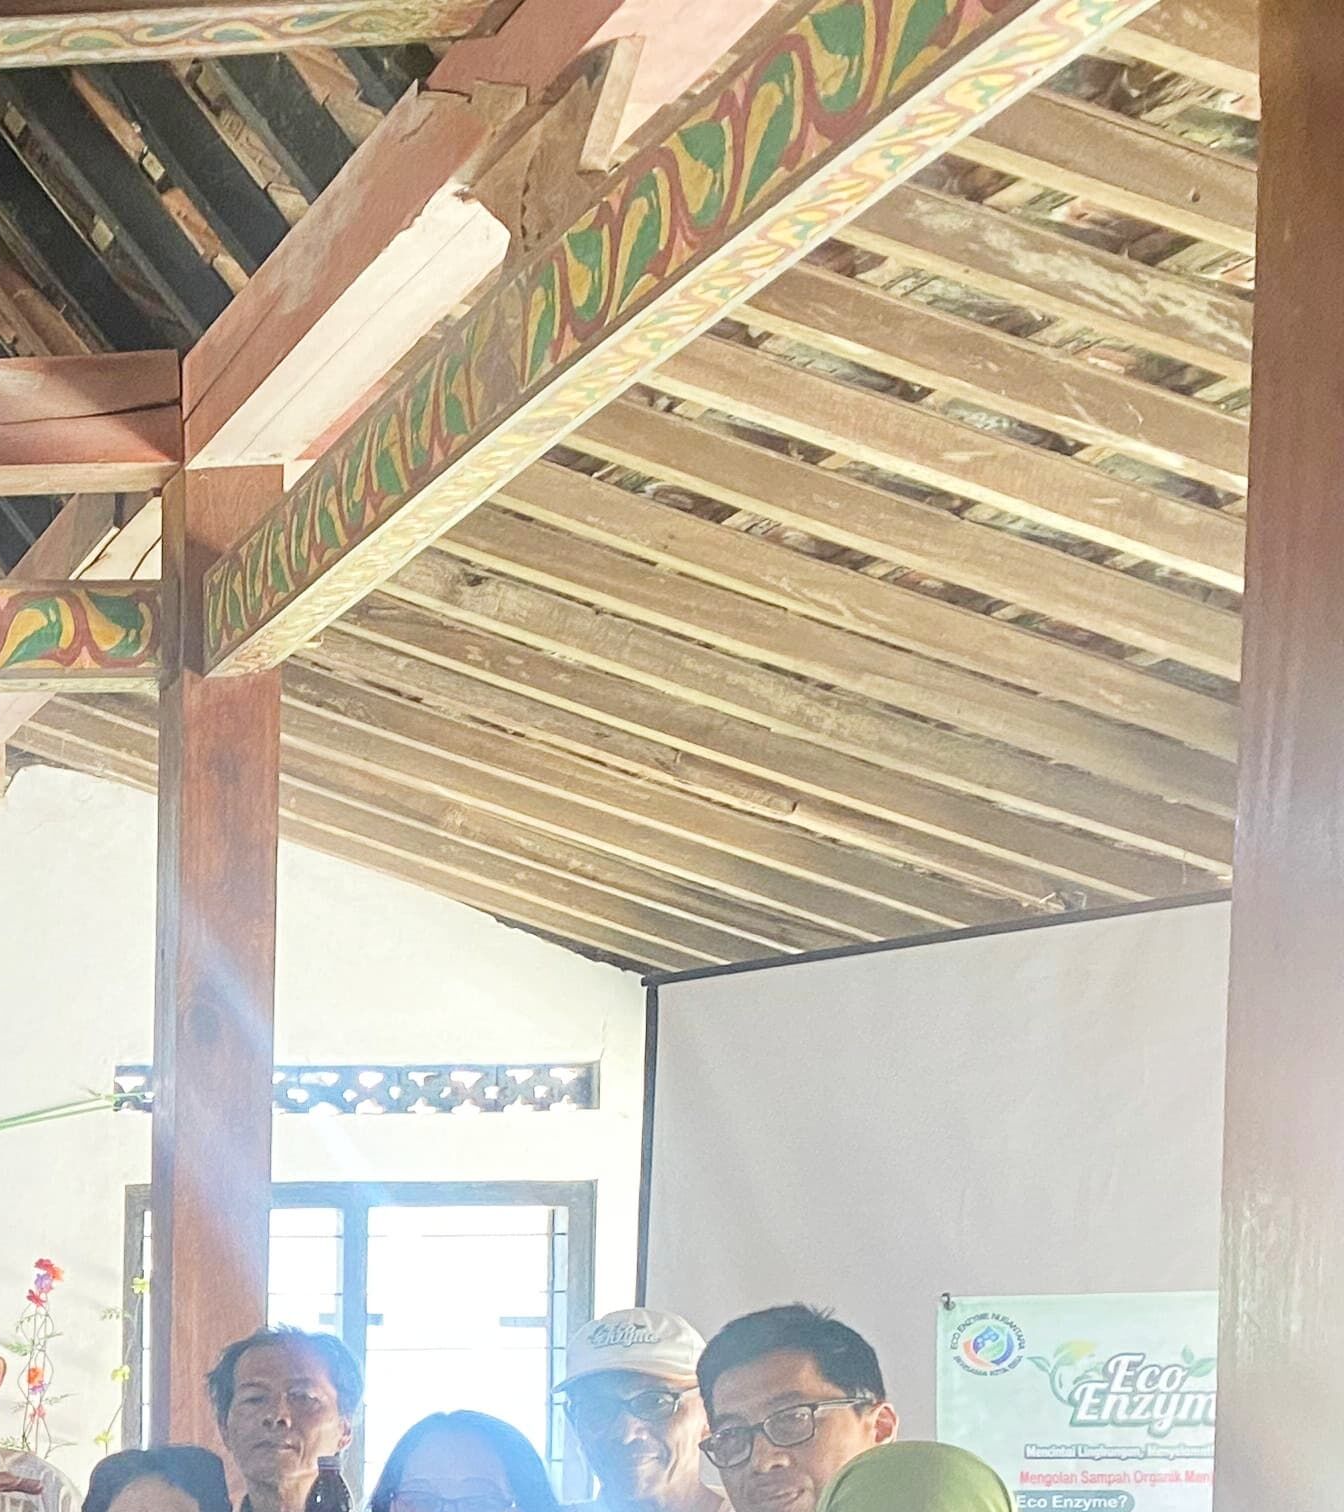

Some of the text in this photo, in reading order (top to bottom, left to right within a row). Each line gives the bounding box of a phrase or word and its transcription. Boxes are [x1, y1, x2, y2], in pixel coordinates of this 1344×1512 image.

[1106, 1353, 1186, 1393] Eco
[1074, 1382, 1215, 1434] Enzym
[1081, 1471, 1131, 1486] Sampah
[1018, 1495, 1128, 1512] Eco Enzyme?
